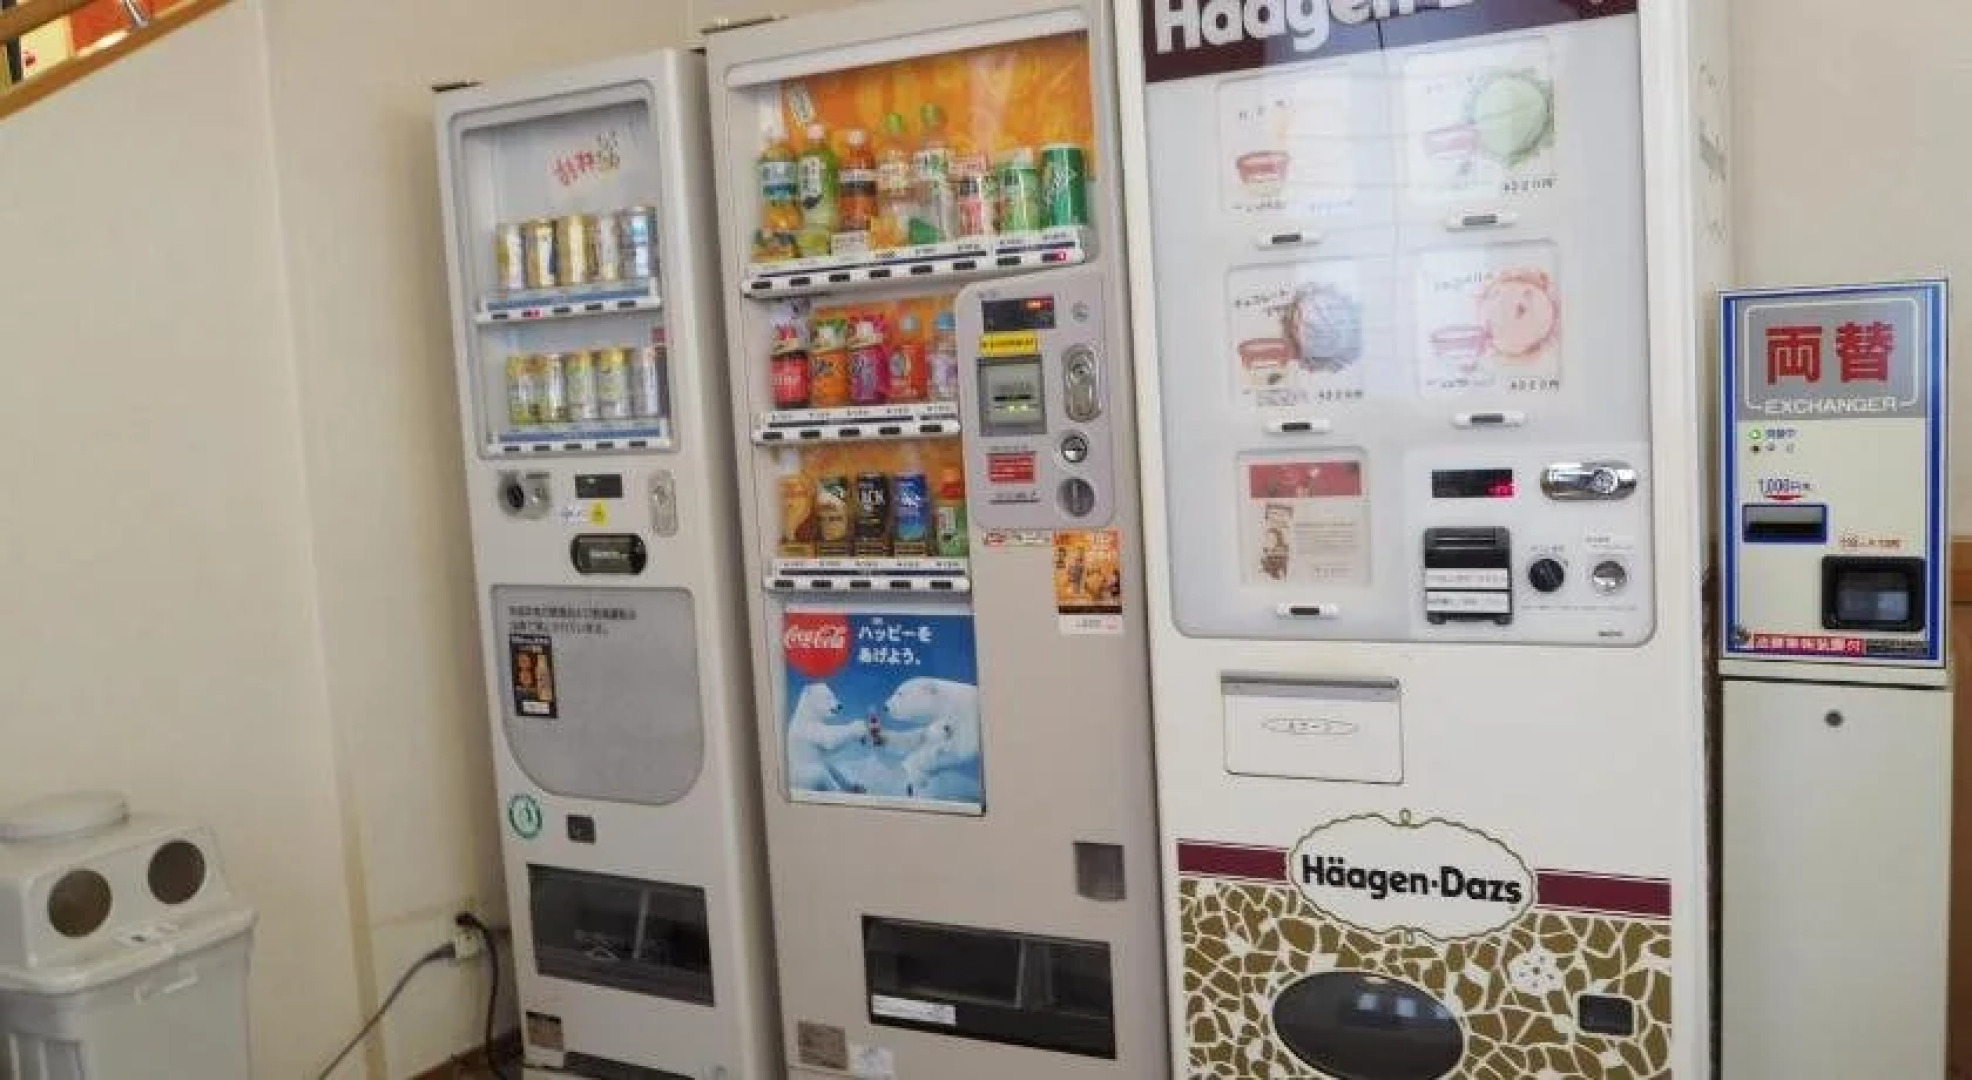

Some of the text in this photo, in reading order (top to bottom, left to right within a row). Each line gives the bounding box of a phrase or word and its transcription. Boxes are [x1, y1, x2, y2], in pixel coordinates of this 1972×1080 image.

[1764, 320, 1895, 386] 両替
[1764, 396, 1898, 414] EXCHANGER
[858, 624, 933, 644] ハッピーを
